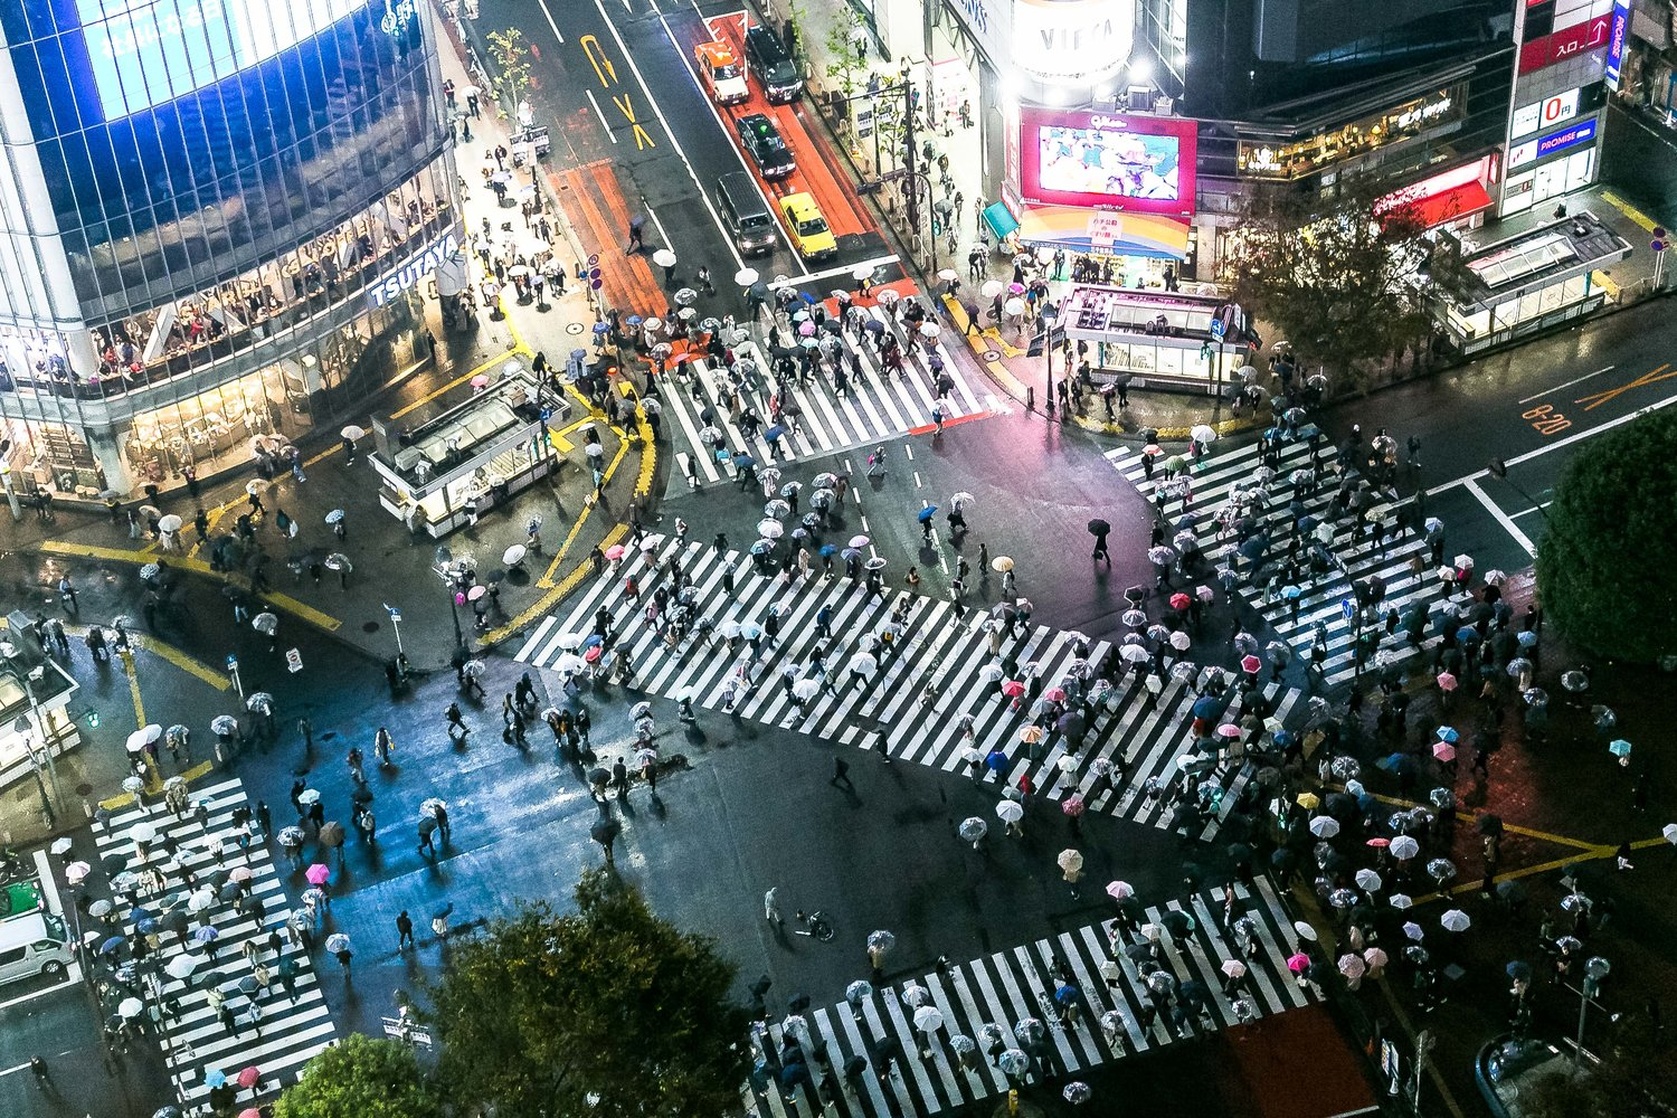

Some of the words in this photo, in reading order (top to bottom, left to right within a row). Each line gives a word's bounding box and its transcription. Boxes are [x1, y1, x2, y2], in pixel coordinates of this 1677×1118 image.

[1556, 41, 1578, 57] 入口
[1612, 15, 1625, 59] PROMISE
[1541, 131, 1577, 151] PROMISE
[370, 234, 459, 306] TSUTAYA
[1522, 404, 1572, 435] 8-20
